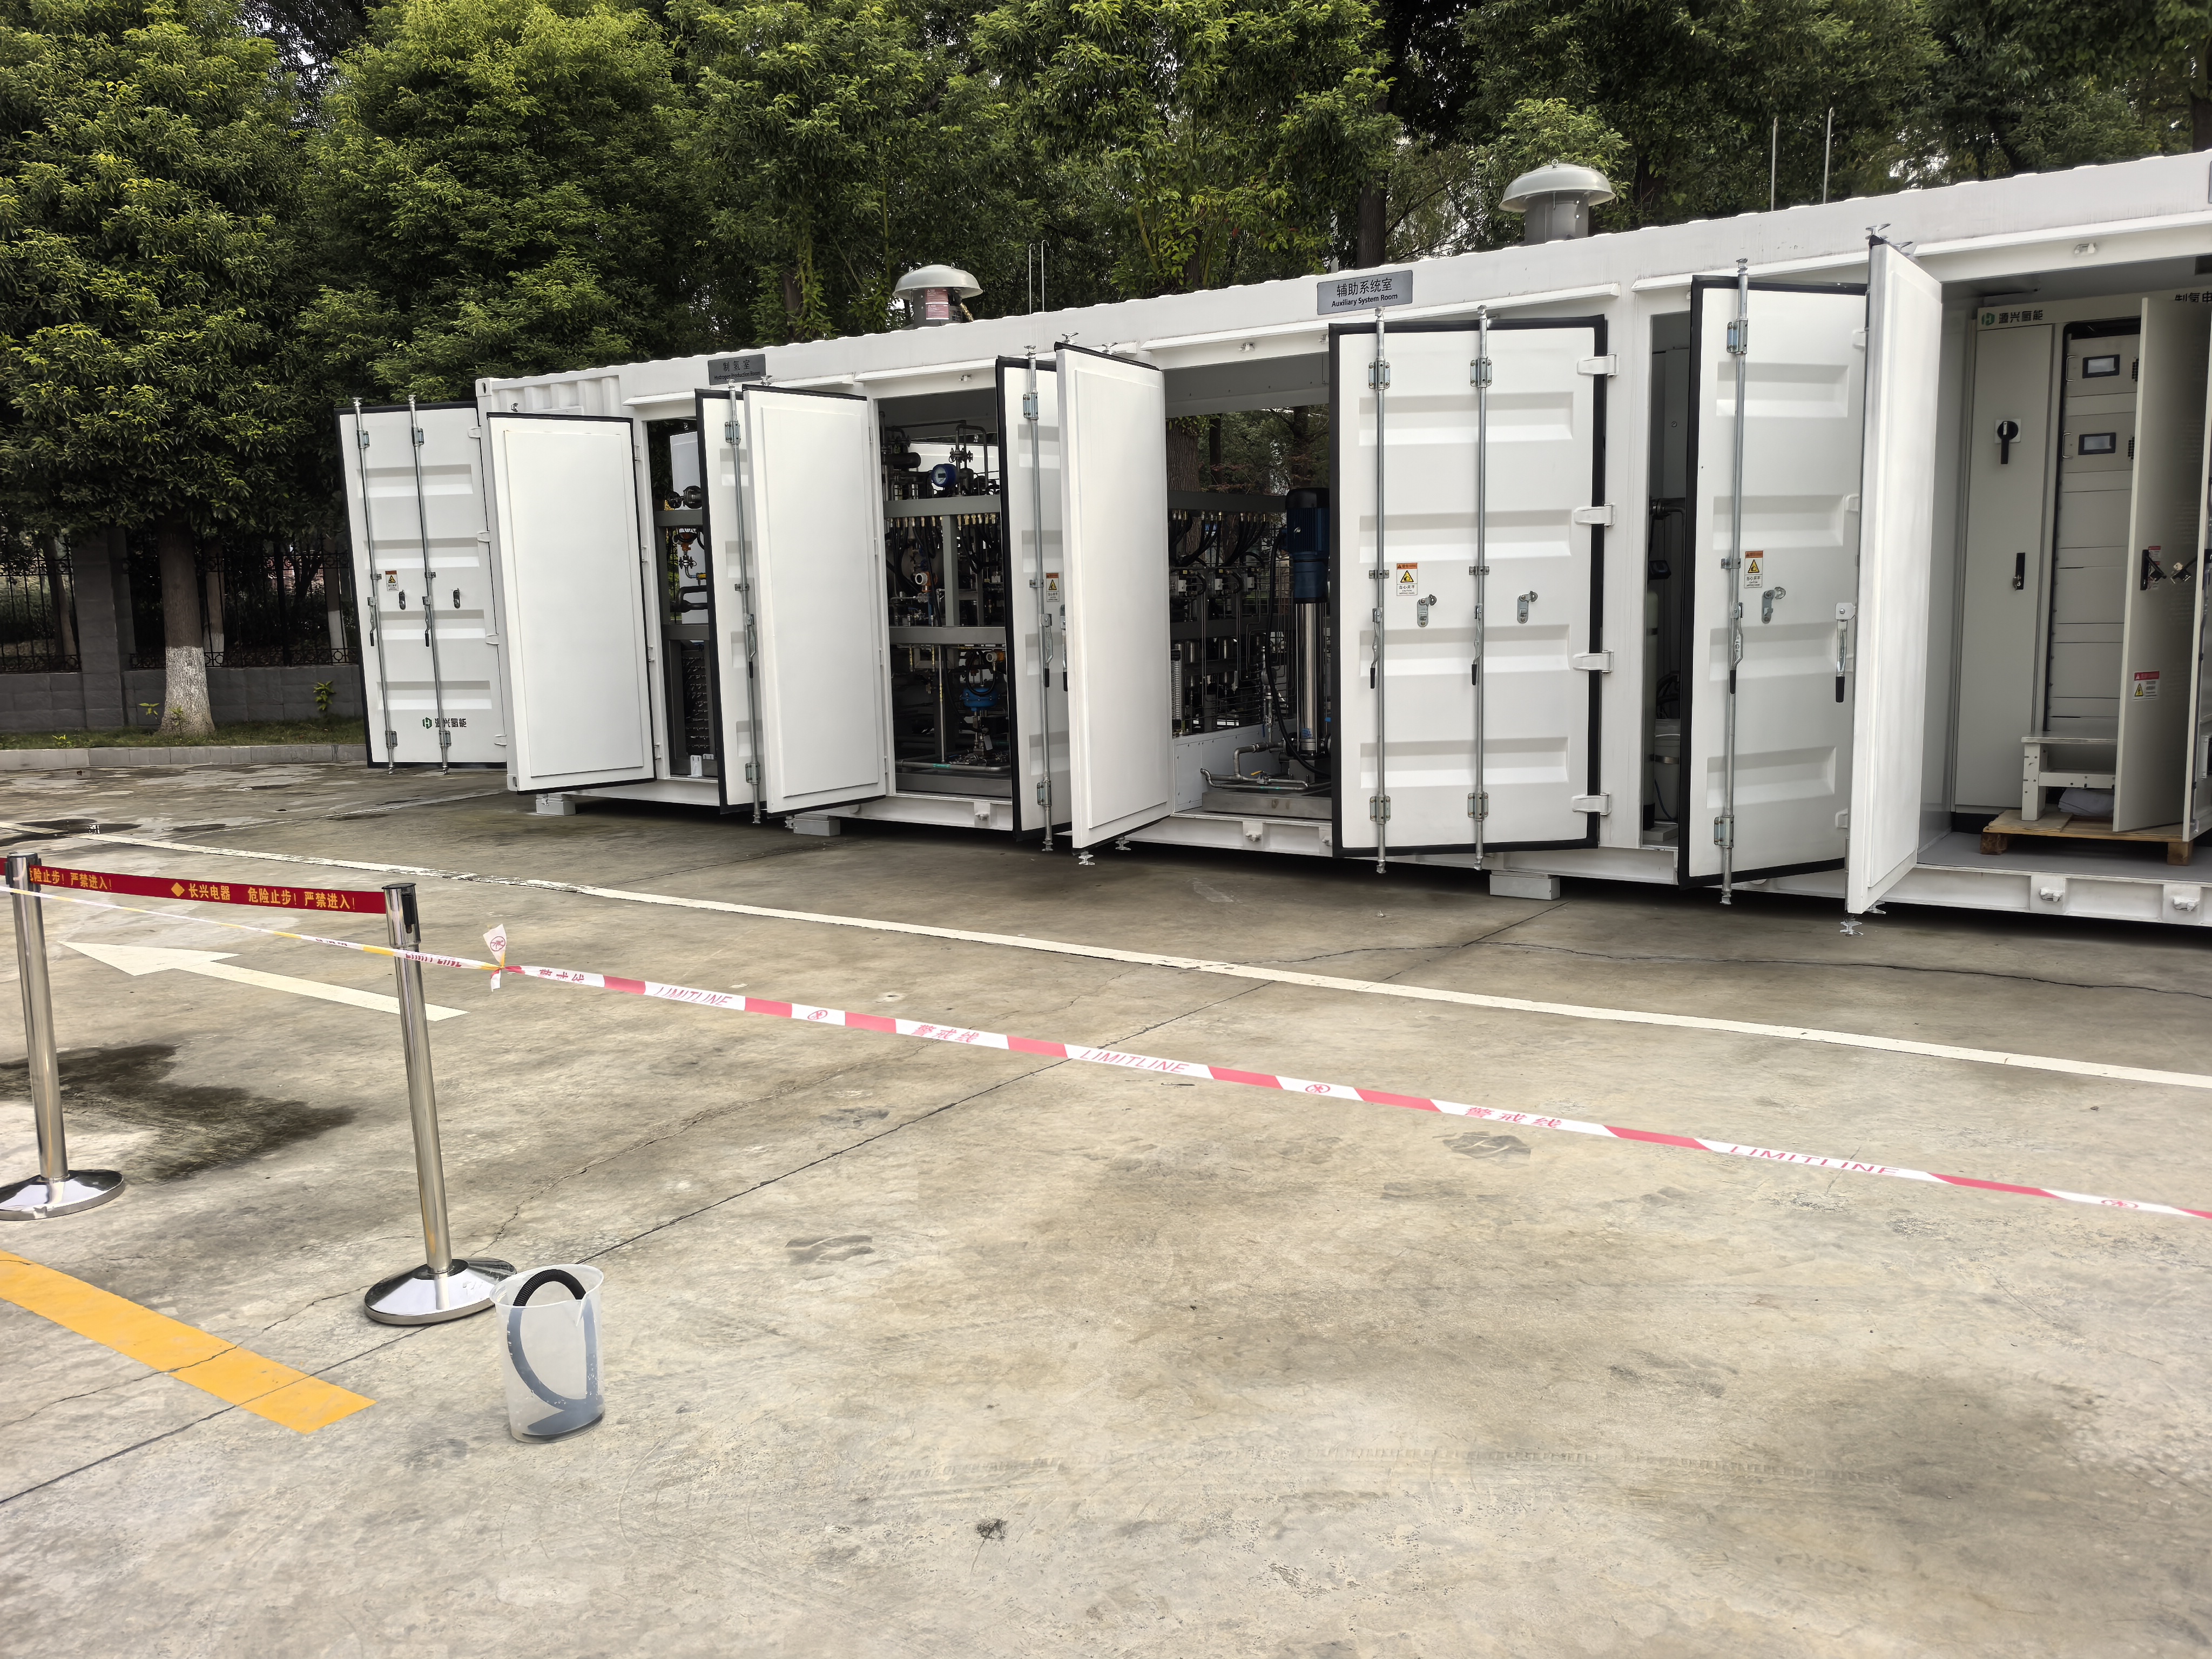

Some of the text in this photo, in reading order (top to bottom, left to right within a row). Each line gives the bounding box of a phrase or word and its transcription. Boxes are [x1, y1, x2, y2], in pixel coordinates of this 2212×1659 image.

[1337, 277, 1392, 298] 辅助系统室
[1332, 298, 1357, 307] Auxiliary
[1358, 296, 1379, 304] System
[723, 360, 751, 372] 制氢室
[188, 883, 230, 901] 长兴电器
[911, 1024, 980, 1043] 警戒线
[1465, 1107, 1562, 1129] 警戒线
